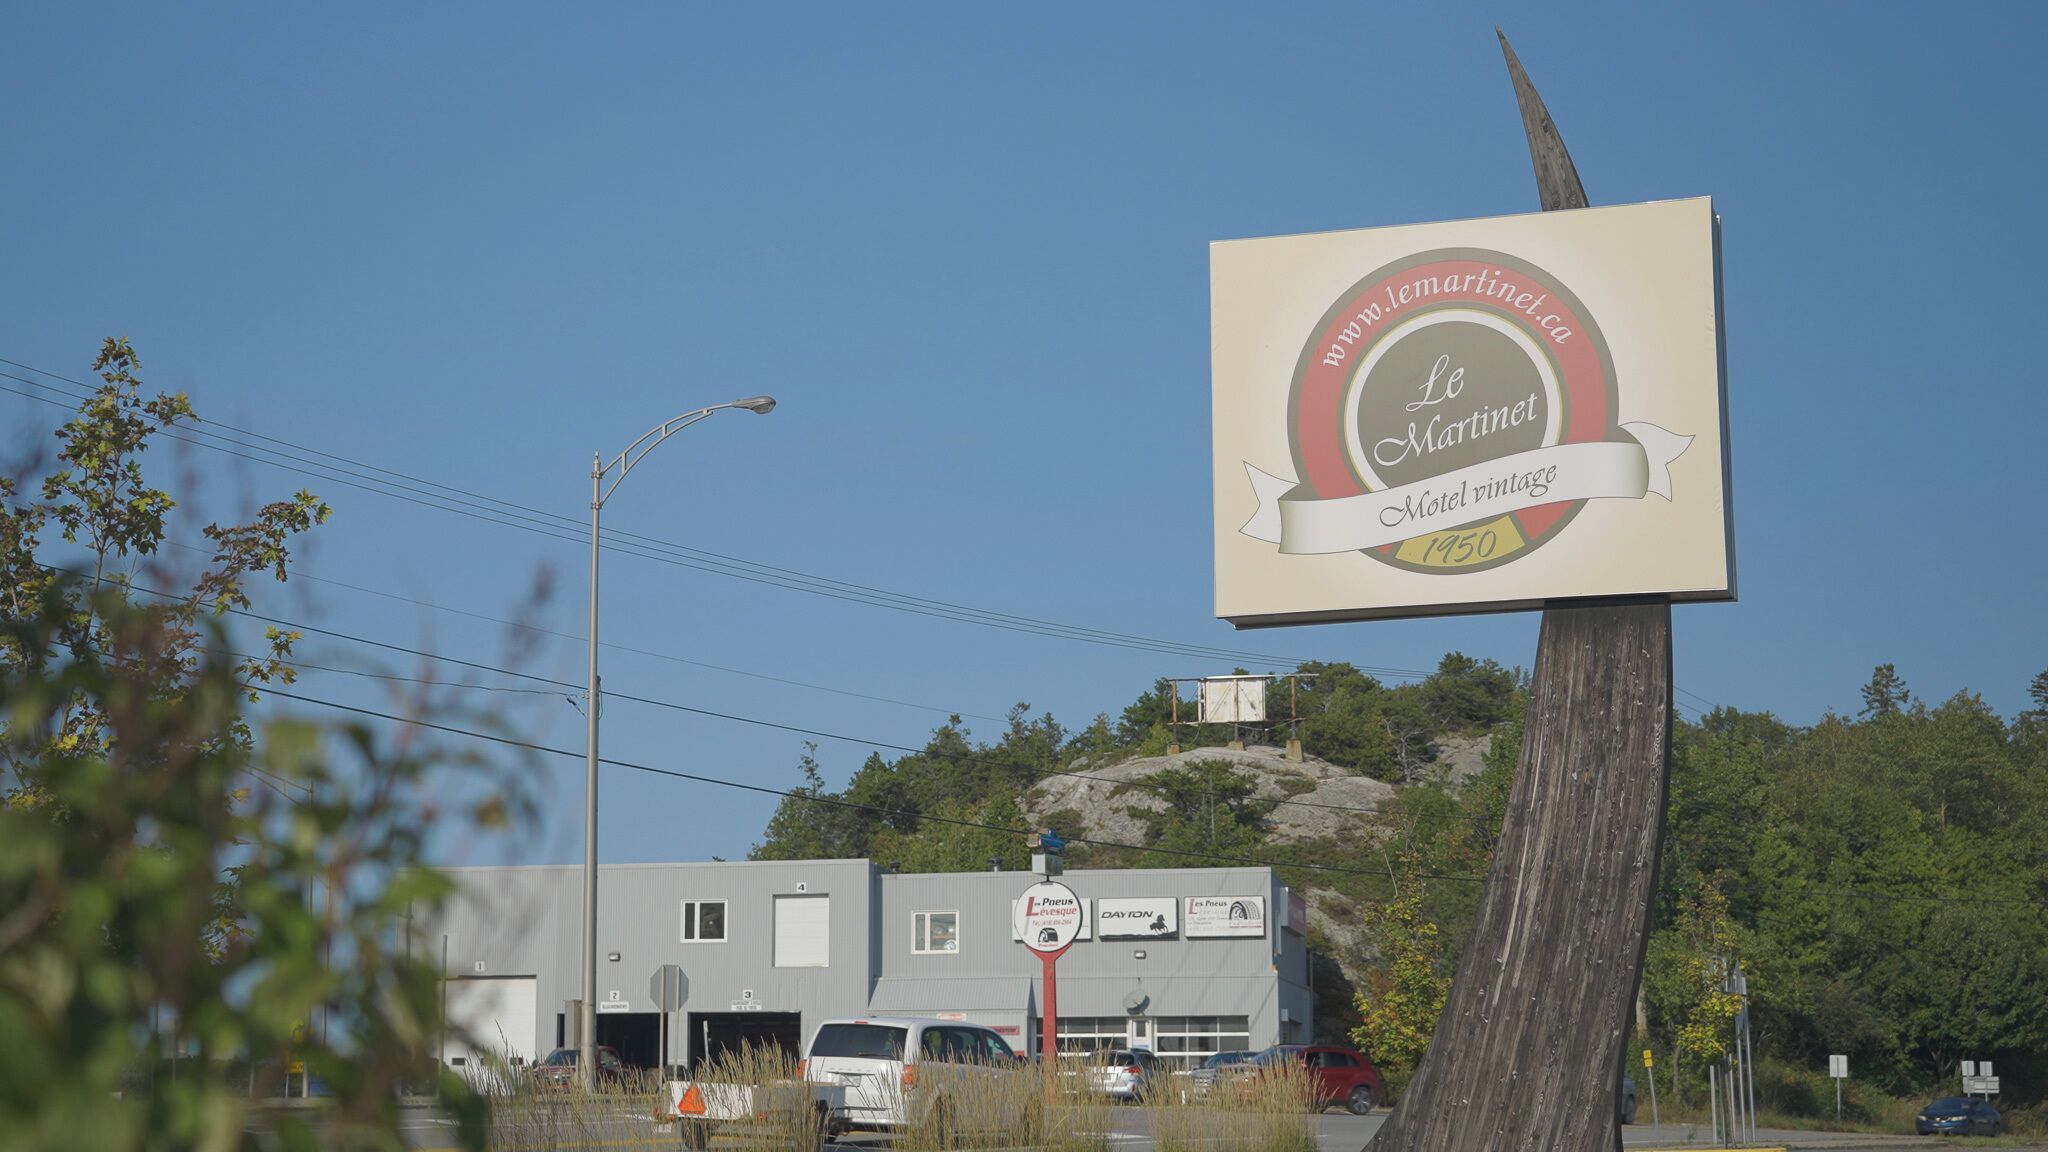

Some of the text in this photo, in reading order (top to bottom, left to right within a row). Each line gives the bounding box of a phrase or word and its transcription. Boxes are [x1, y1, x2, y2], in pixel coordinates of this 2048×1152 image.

[1323, 269, 1572, 367] www.lemartinet.ca
[1405, 354, 1465, 412] Le
[1374, 392, 1537, 467] Martinet
[1379, 464, 1557, 528] Motel vintage
[1422, 529, 1497, 564] 1950
[1042, 897, 1074, 906] Pneus
[1101, 910, 1154, 919] DAYTON
[744, 991, 752, 999] 3
